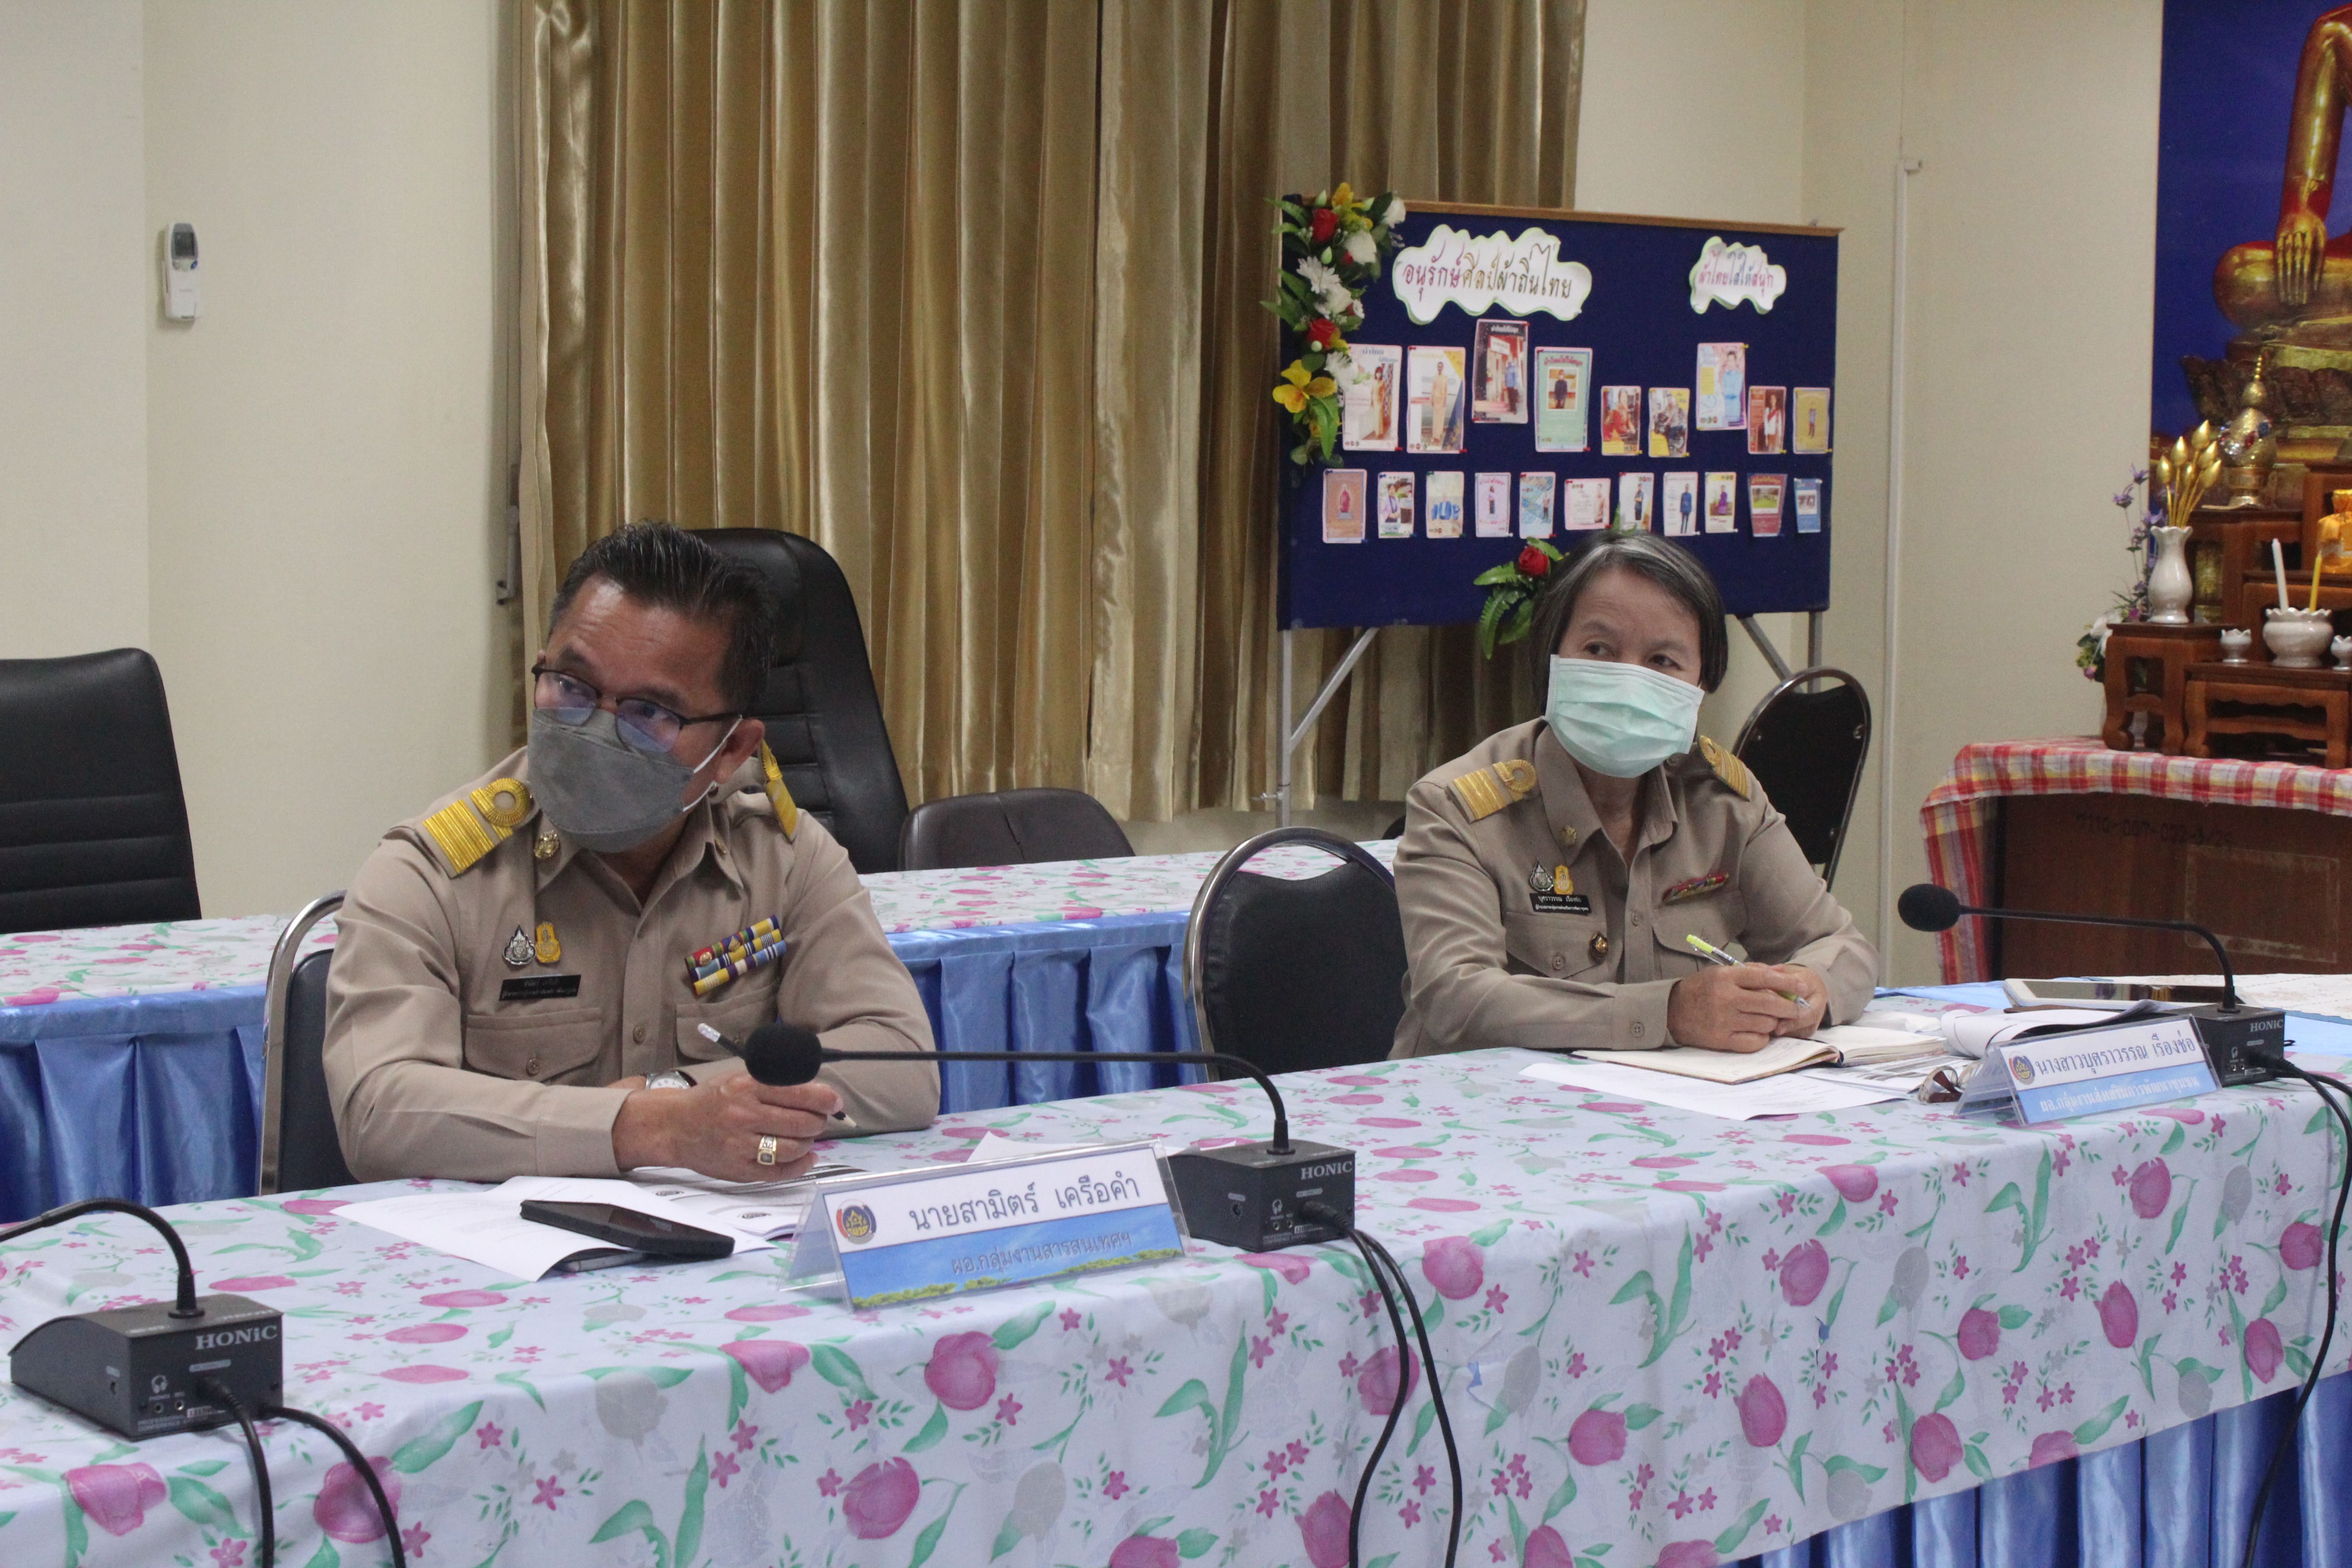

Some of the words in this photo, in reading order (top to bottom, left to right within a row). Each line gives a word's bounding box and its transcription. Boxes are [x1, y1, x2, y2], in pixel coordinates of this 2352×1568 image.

[909, 1182, 1039, 1230] นายสามิตร์
[1054, 1171, 1141, 1209] เครือคำ
